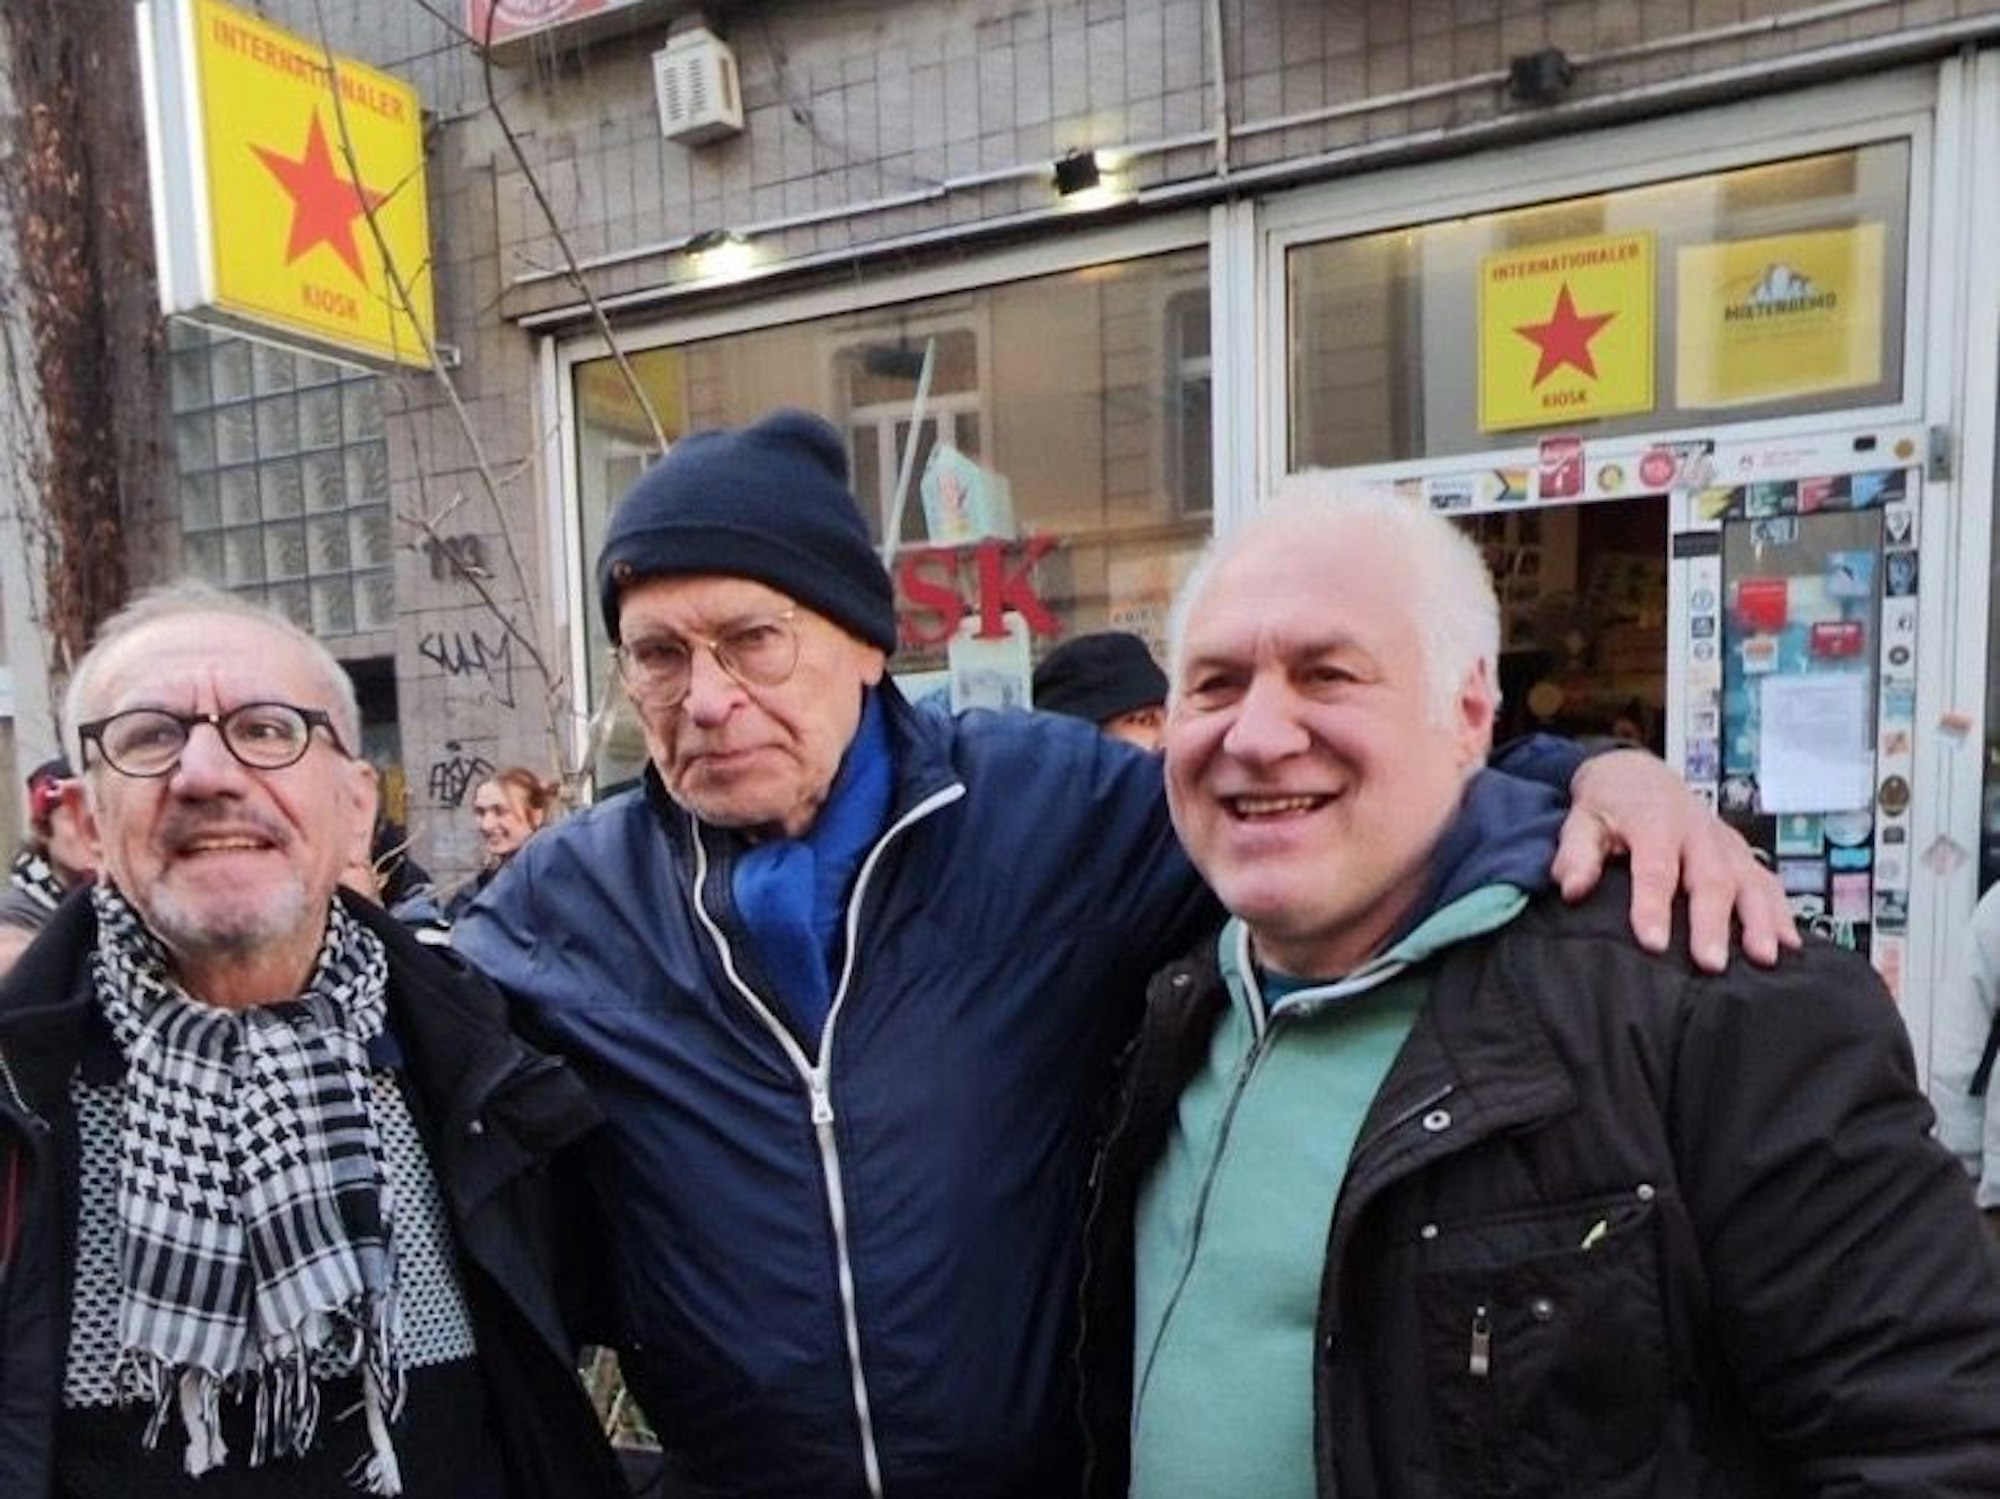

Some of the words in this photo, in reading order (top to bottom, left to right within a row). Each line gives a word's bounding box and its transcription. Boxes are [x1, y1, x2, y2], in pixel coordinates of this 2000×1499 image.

[213, 20, 405, 122] INTERNATINALER
[1493, 242, 1639, 281] INTERNATIONALER
[302, 283, 359, 321] KIOSK
[1542, 389, 1588, 408] KIOSK
